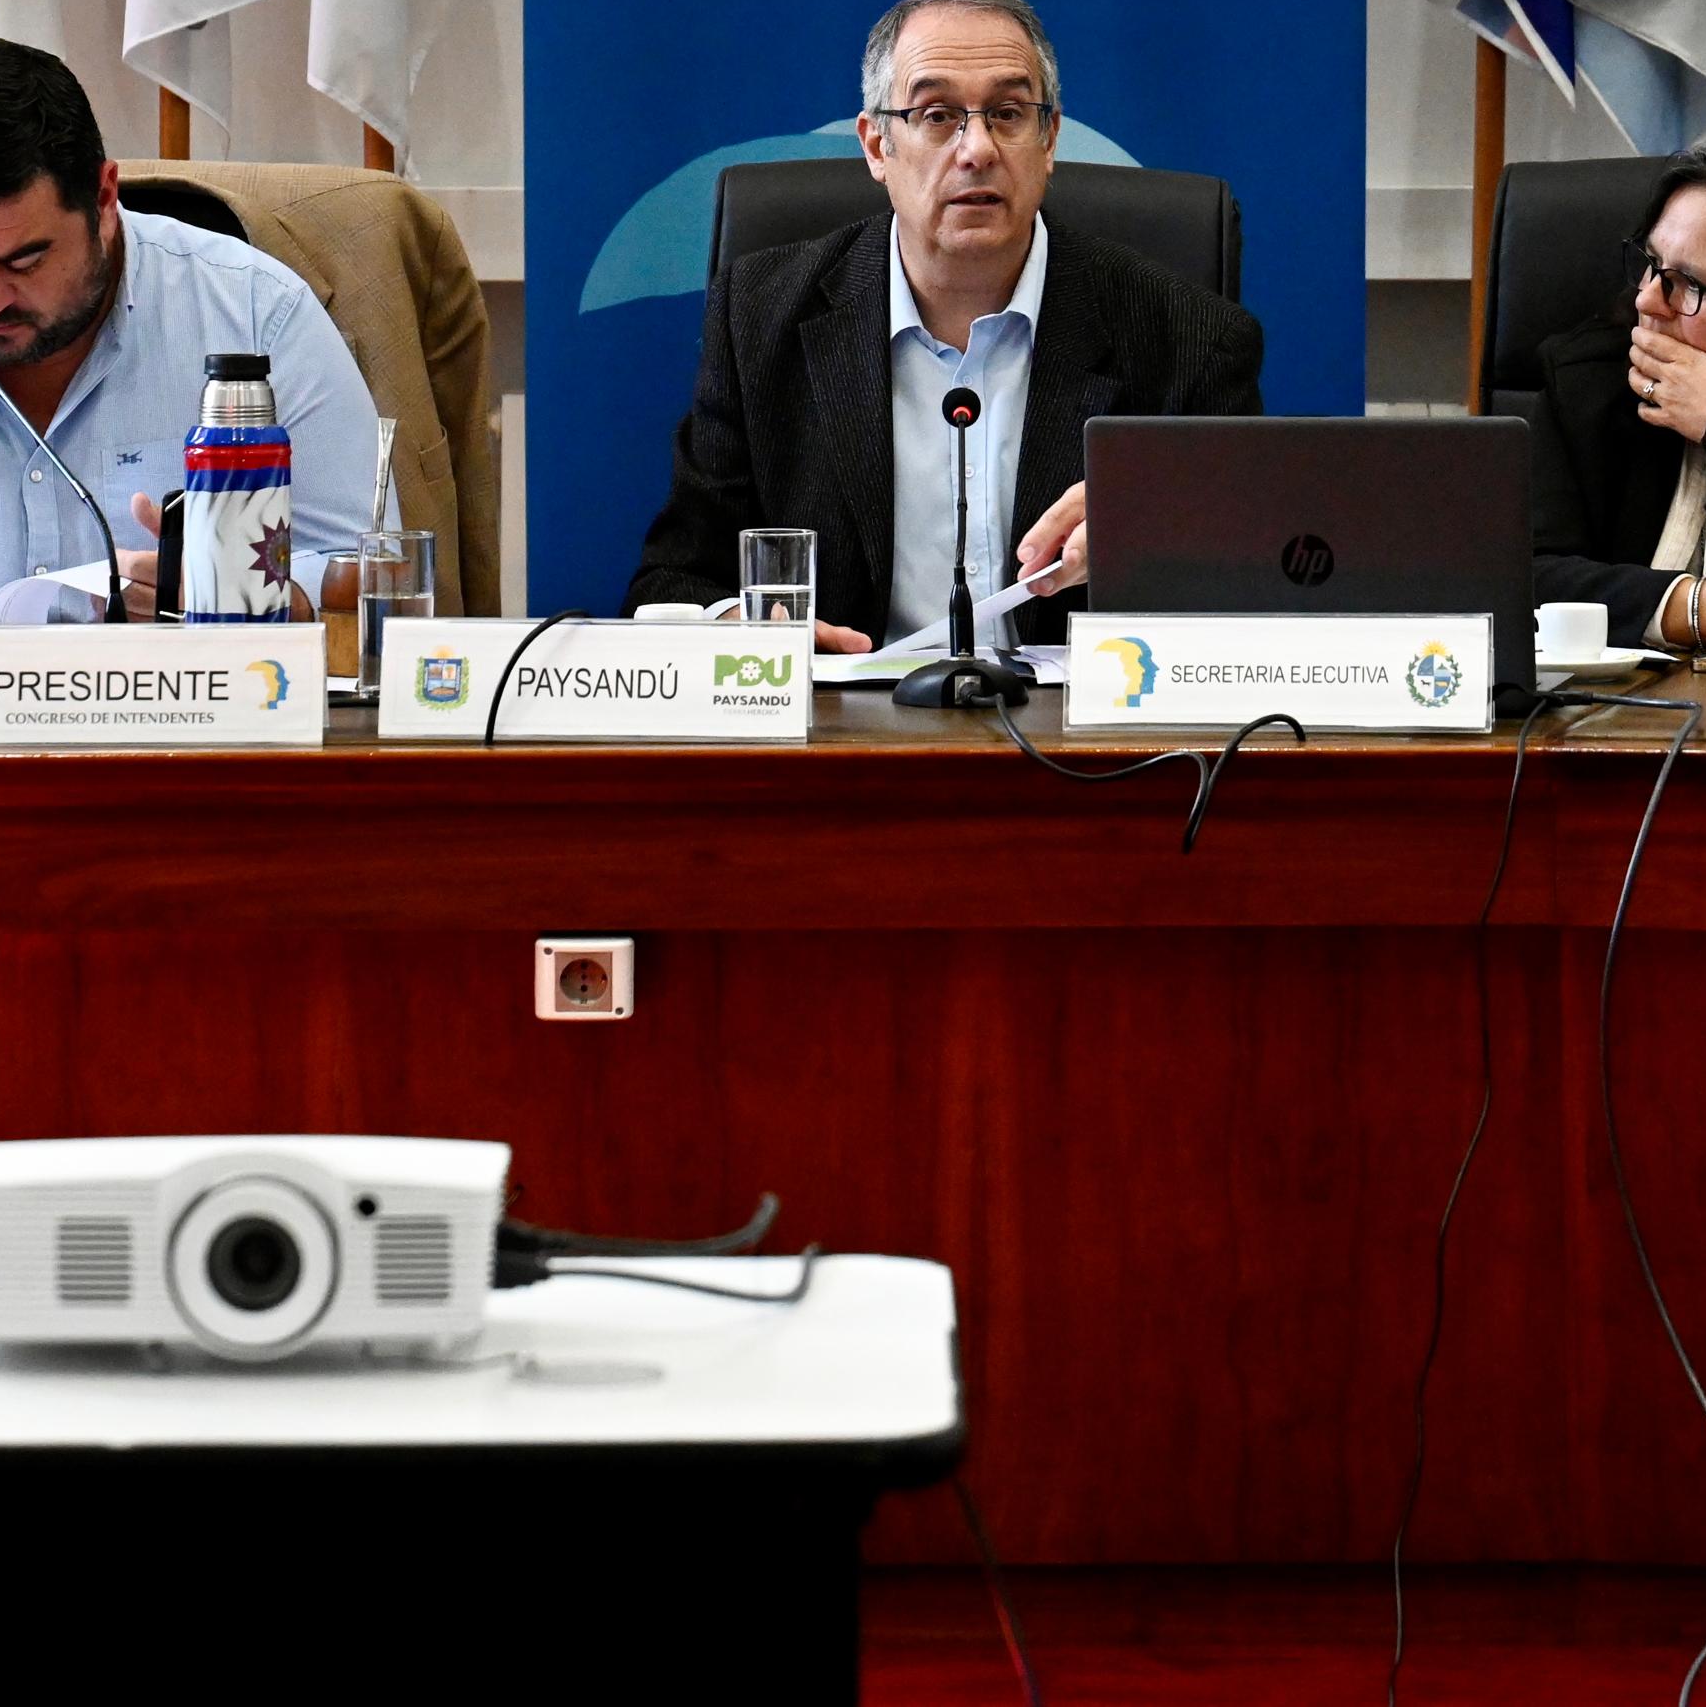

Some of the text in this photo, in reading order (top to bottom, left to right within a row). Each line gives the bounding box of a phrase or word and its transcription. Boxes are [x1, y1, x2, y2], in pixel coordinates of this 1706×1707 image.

[1288, 534, 1329, 586] hp
[517, 662, 679, 700] PAYSANDÚ
[1171, 664, 1389, 684] SECRETARIA EJECUTIVA
[713, 692, 791, 707] PAYSANDÚ
[5, 712, 215, 725] CONGRESO DE INTENDENTES
